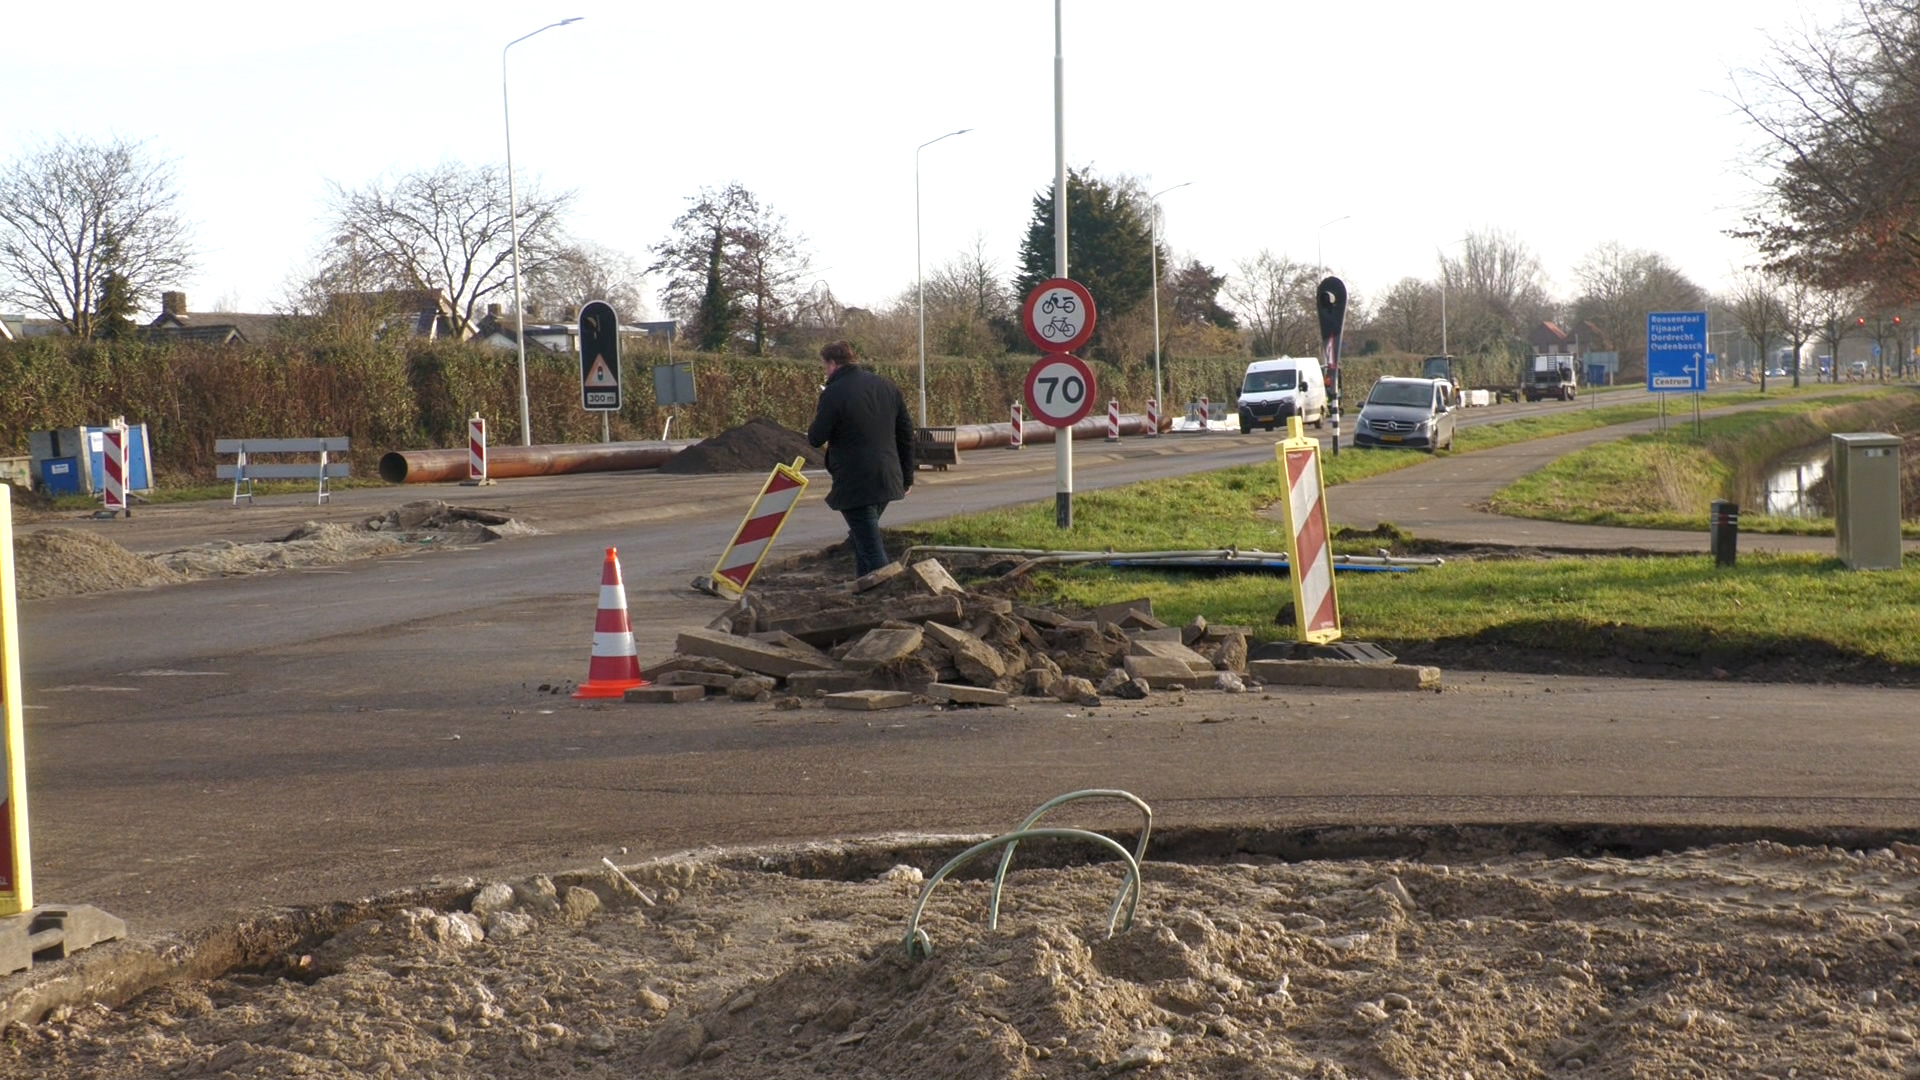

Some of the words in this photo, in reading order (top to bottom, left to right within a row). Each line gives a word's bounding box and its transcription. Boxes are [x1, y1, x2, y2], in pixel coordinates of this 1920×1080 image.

[1651, 315, 1700, 323] Roosendaal
[1651, 325, 1684, 333] Fijnaart
[1651, 343, 1702, 351] Oudenbosch
[1655, 378, 1690, 386] Centrum
[1037, 375, 1084, 405] 70
[589, 394, 605, 402] 300
